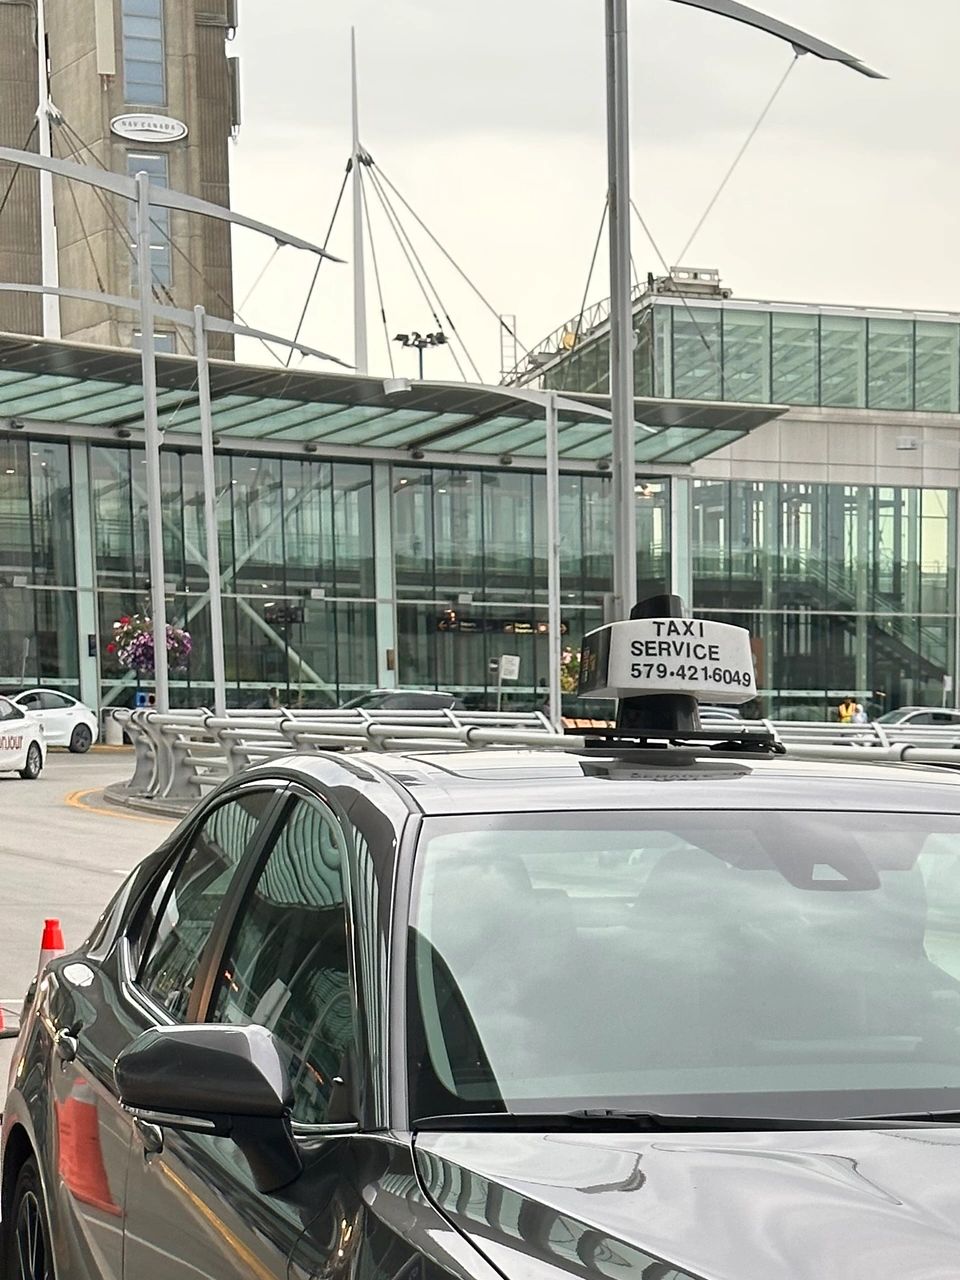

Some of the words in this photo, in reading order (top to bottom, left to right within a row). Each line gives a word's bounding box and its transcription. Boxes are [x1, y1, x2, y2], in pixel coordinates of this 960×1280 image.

[121, 120, 138, 128] NAV
[141, 121, 176, 130] CANADA
[652, 620, 704, 638] TAXI
[630, 640, 720, 662] SERVICE
[0, 735, 24, 750] njour
